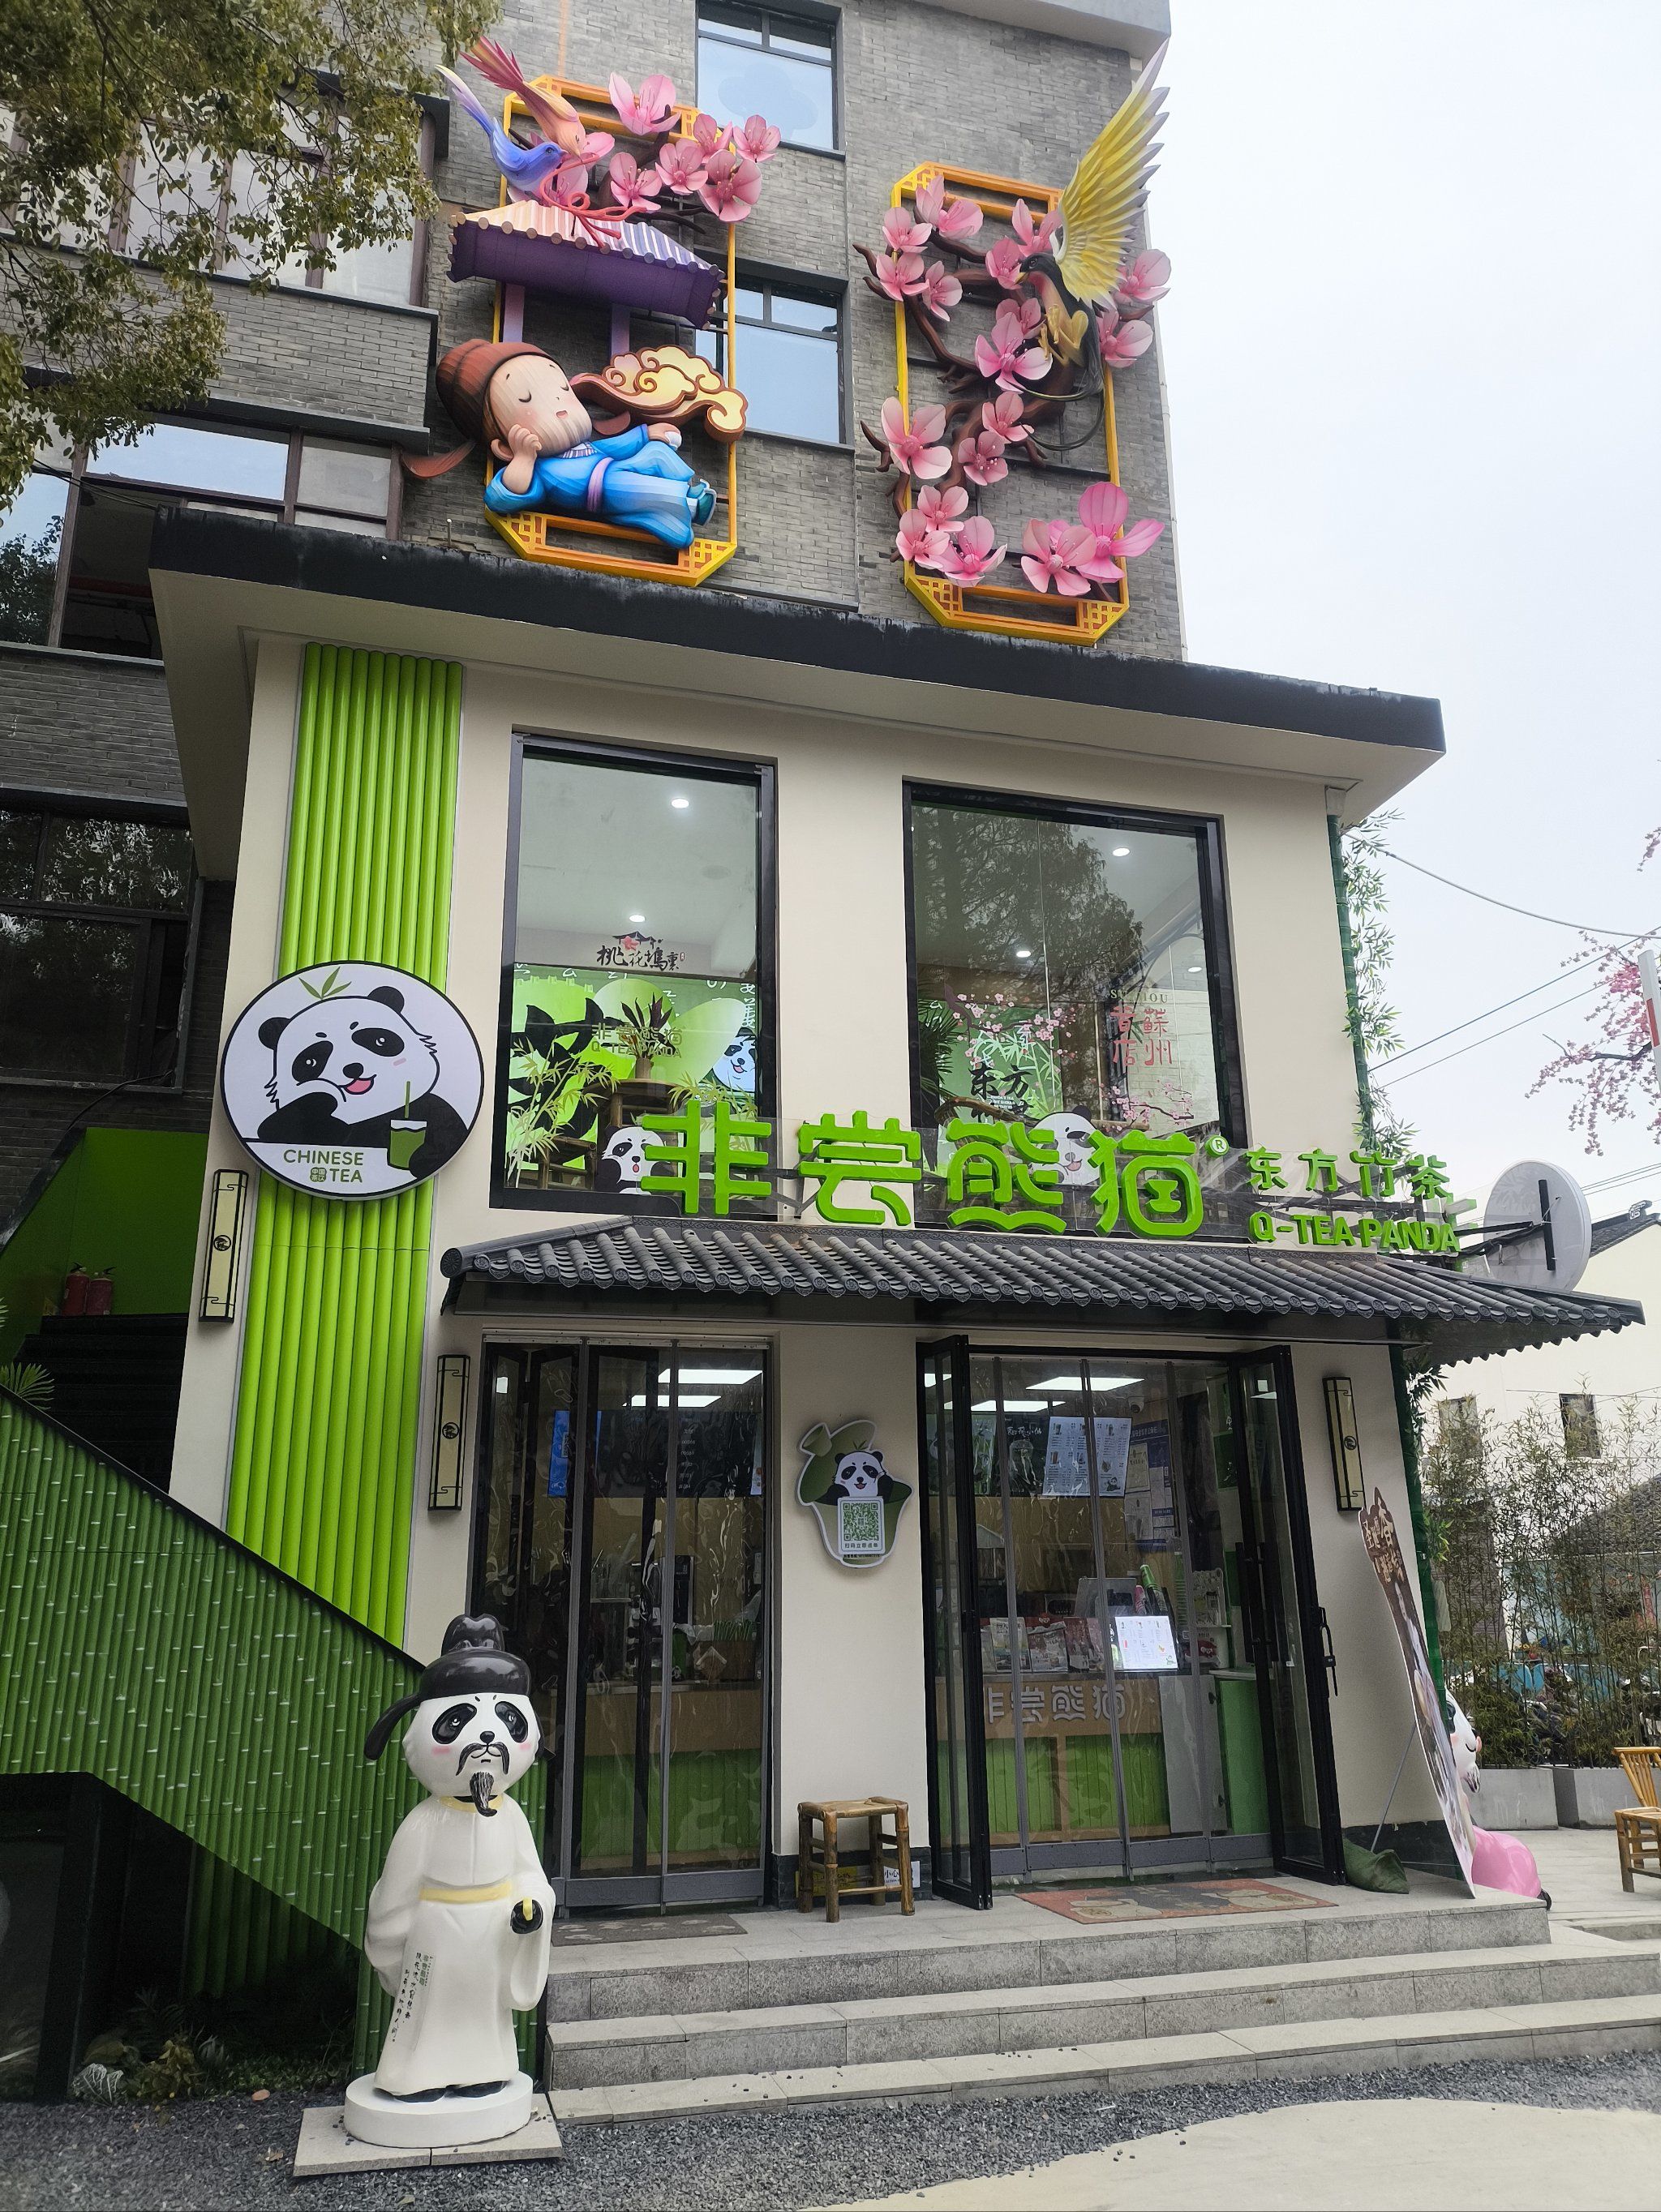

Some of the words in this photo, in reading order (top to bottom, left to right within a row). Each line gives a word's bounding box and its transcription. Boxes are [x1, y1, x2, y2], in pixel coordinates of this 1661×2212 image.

[283, 1148, 365, 1166] CHINESE
[328, 1168, 363, 1184] TEA
[640, 1099, 1204, 1238] 非尝熊猫
[1244, 1147, 1453, 1199] 东方竹茶
[1248, 1211, 1354, 1247] Q-TEA
[1358, 1217, 1461, 1253] PANDA
